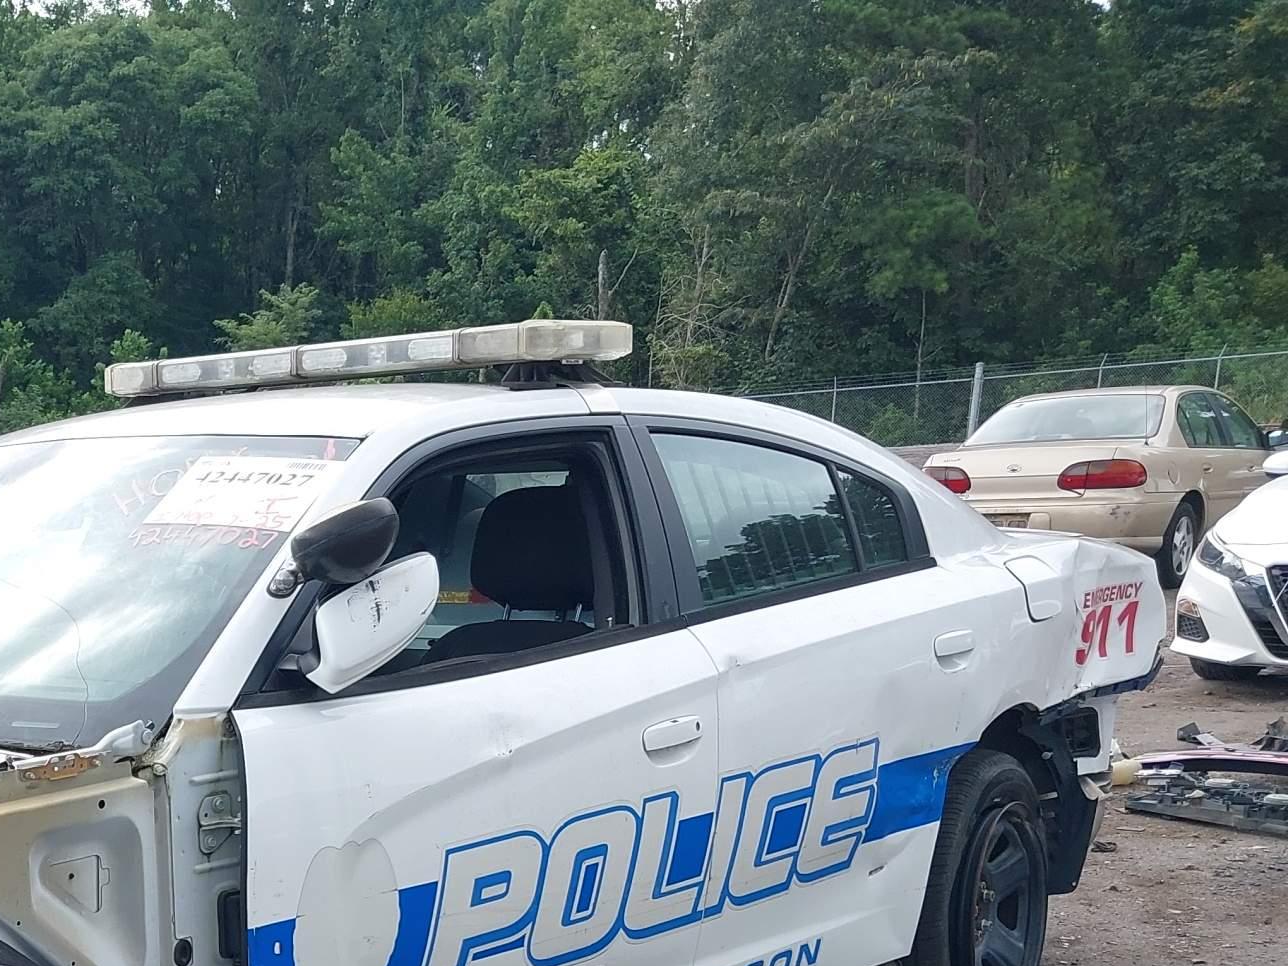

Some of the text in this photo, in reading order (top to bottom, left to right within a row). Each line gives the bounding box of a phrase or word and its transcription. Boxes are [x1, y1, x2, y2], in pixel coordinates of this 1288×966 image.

[195, 471, 314, 487] 42447027
[127, 525, 279, 550] 42447027
[1075, 600, 1140, 666] 911
